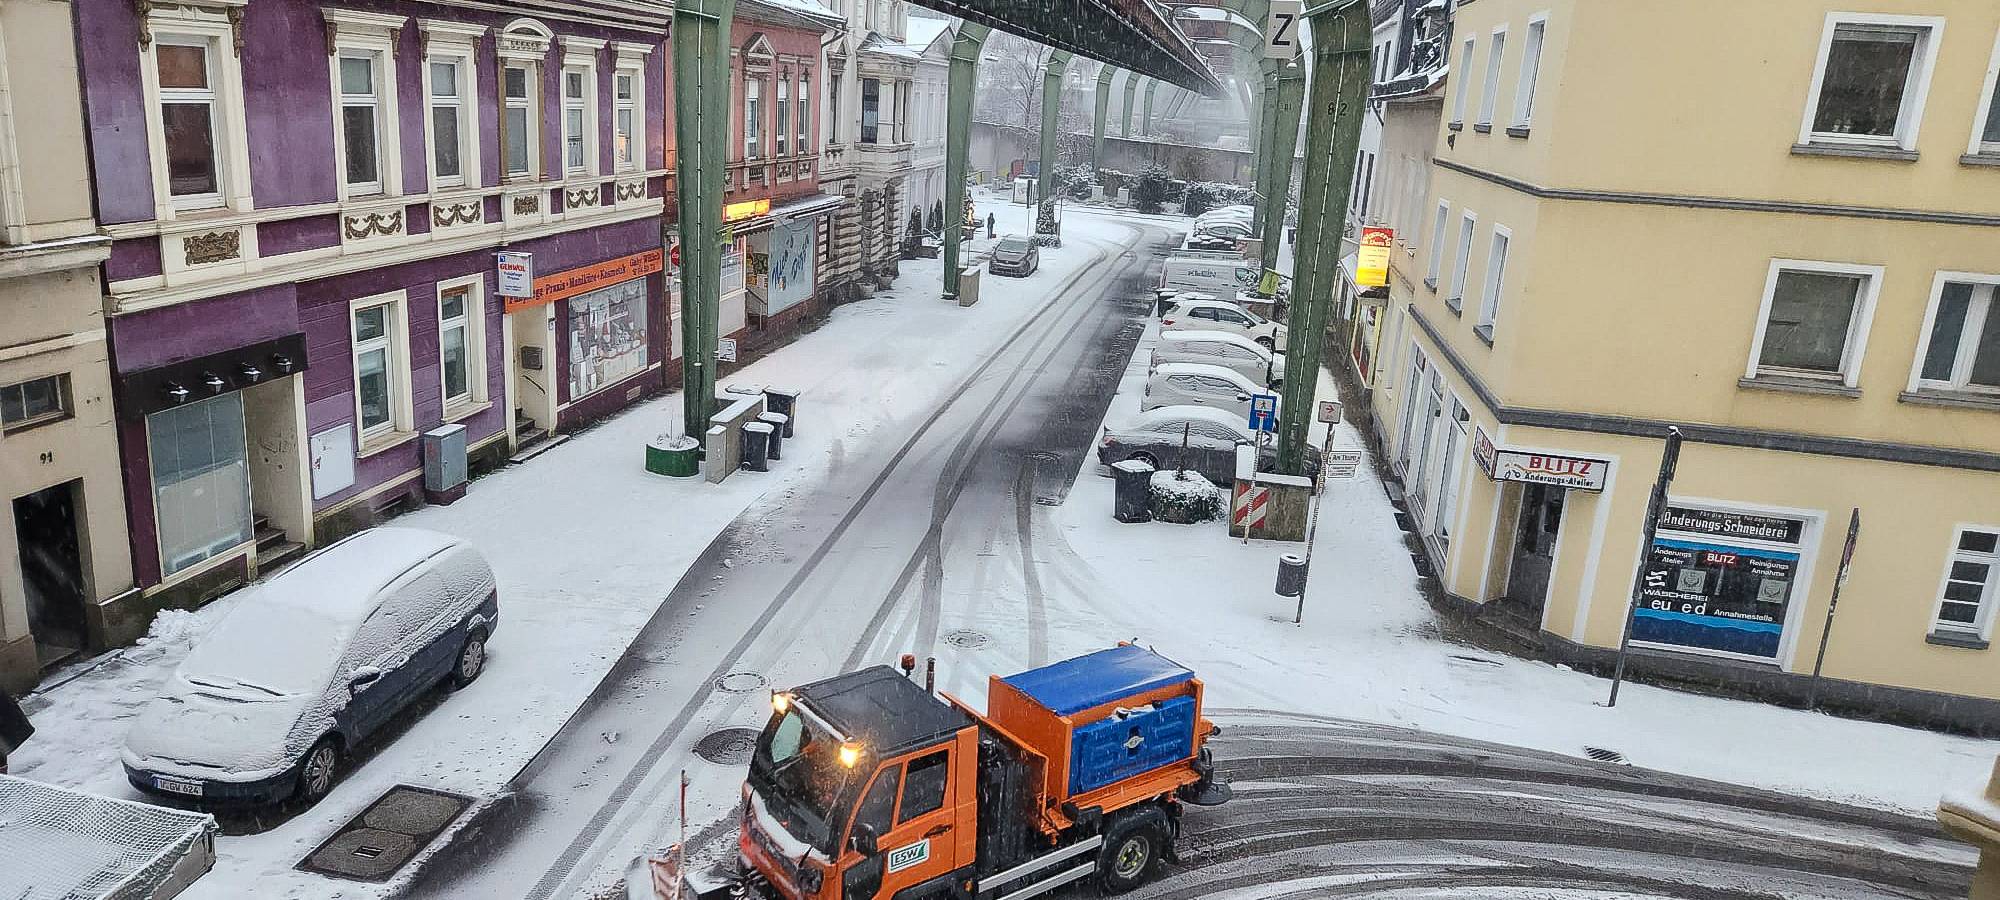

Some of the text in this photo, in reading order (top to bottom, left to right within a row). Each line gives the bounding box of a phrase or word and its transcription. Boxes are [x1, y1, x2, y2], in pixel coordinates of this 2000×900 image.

[1272, 13, 1294, 46] Z
[500, 263, 526, 272] GEHWOL
[40, 450, 53, 464] 91
[1529, 456, 1592, 475] BLITZ
[1524, 471, 1594, 488] Änderungs-Atelier
[1663, 509, 1788, 539] Änderungs-Schneiderei
[1654, 547, 1692, 559] Änderungs
[1707, 552, 1736, 565] BLITZ
[1662, 556, 1684, 566] Atelier
[1750, 558, 1789, 571] Reinigungs
[1751, 567, 1785, 578] Annahme
[1714, 608, 1773, 623] Annahmestelle
[895, 847, 919, 864] ESW
